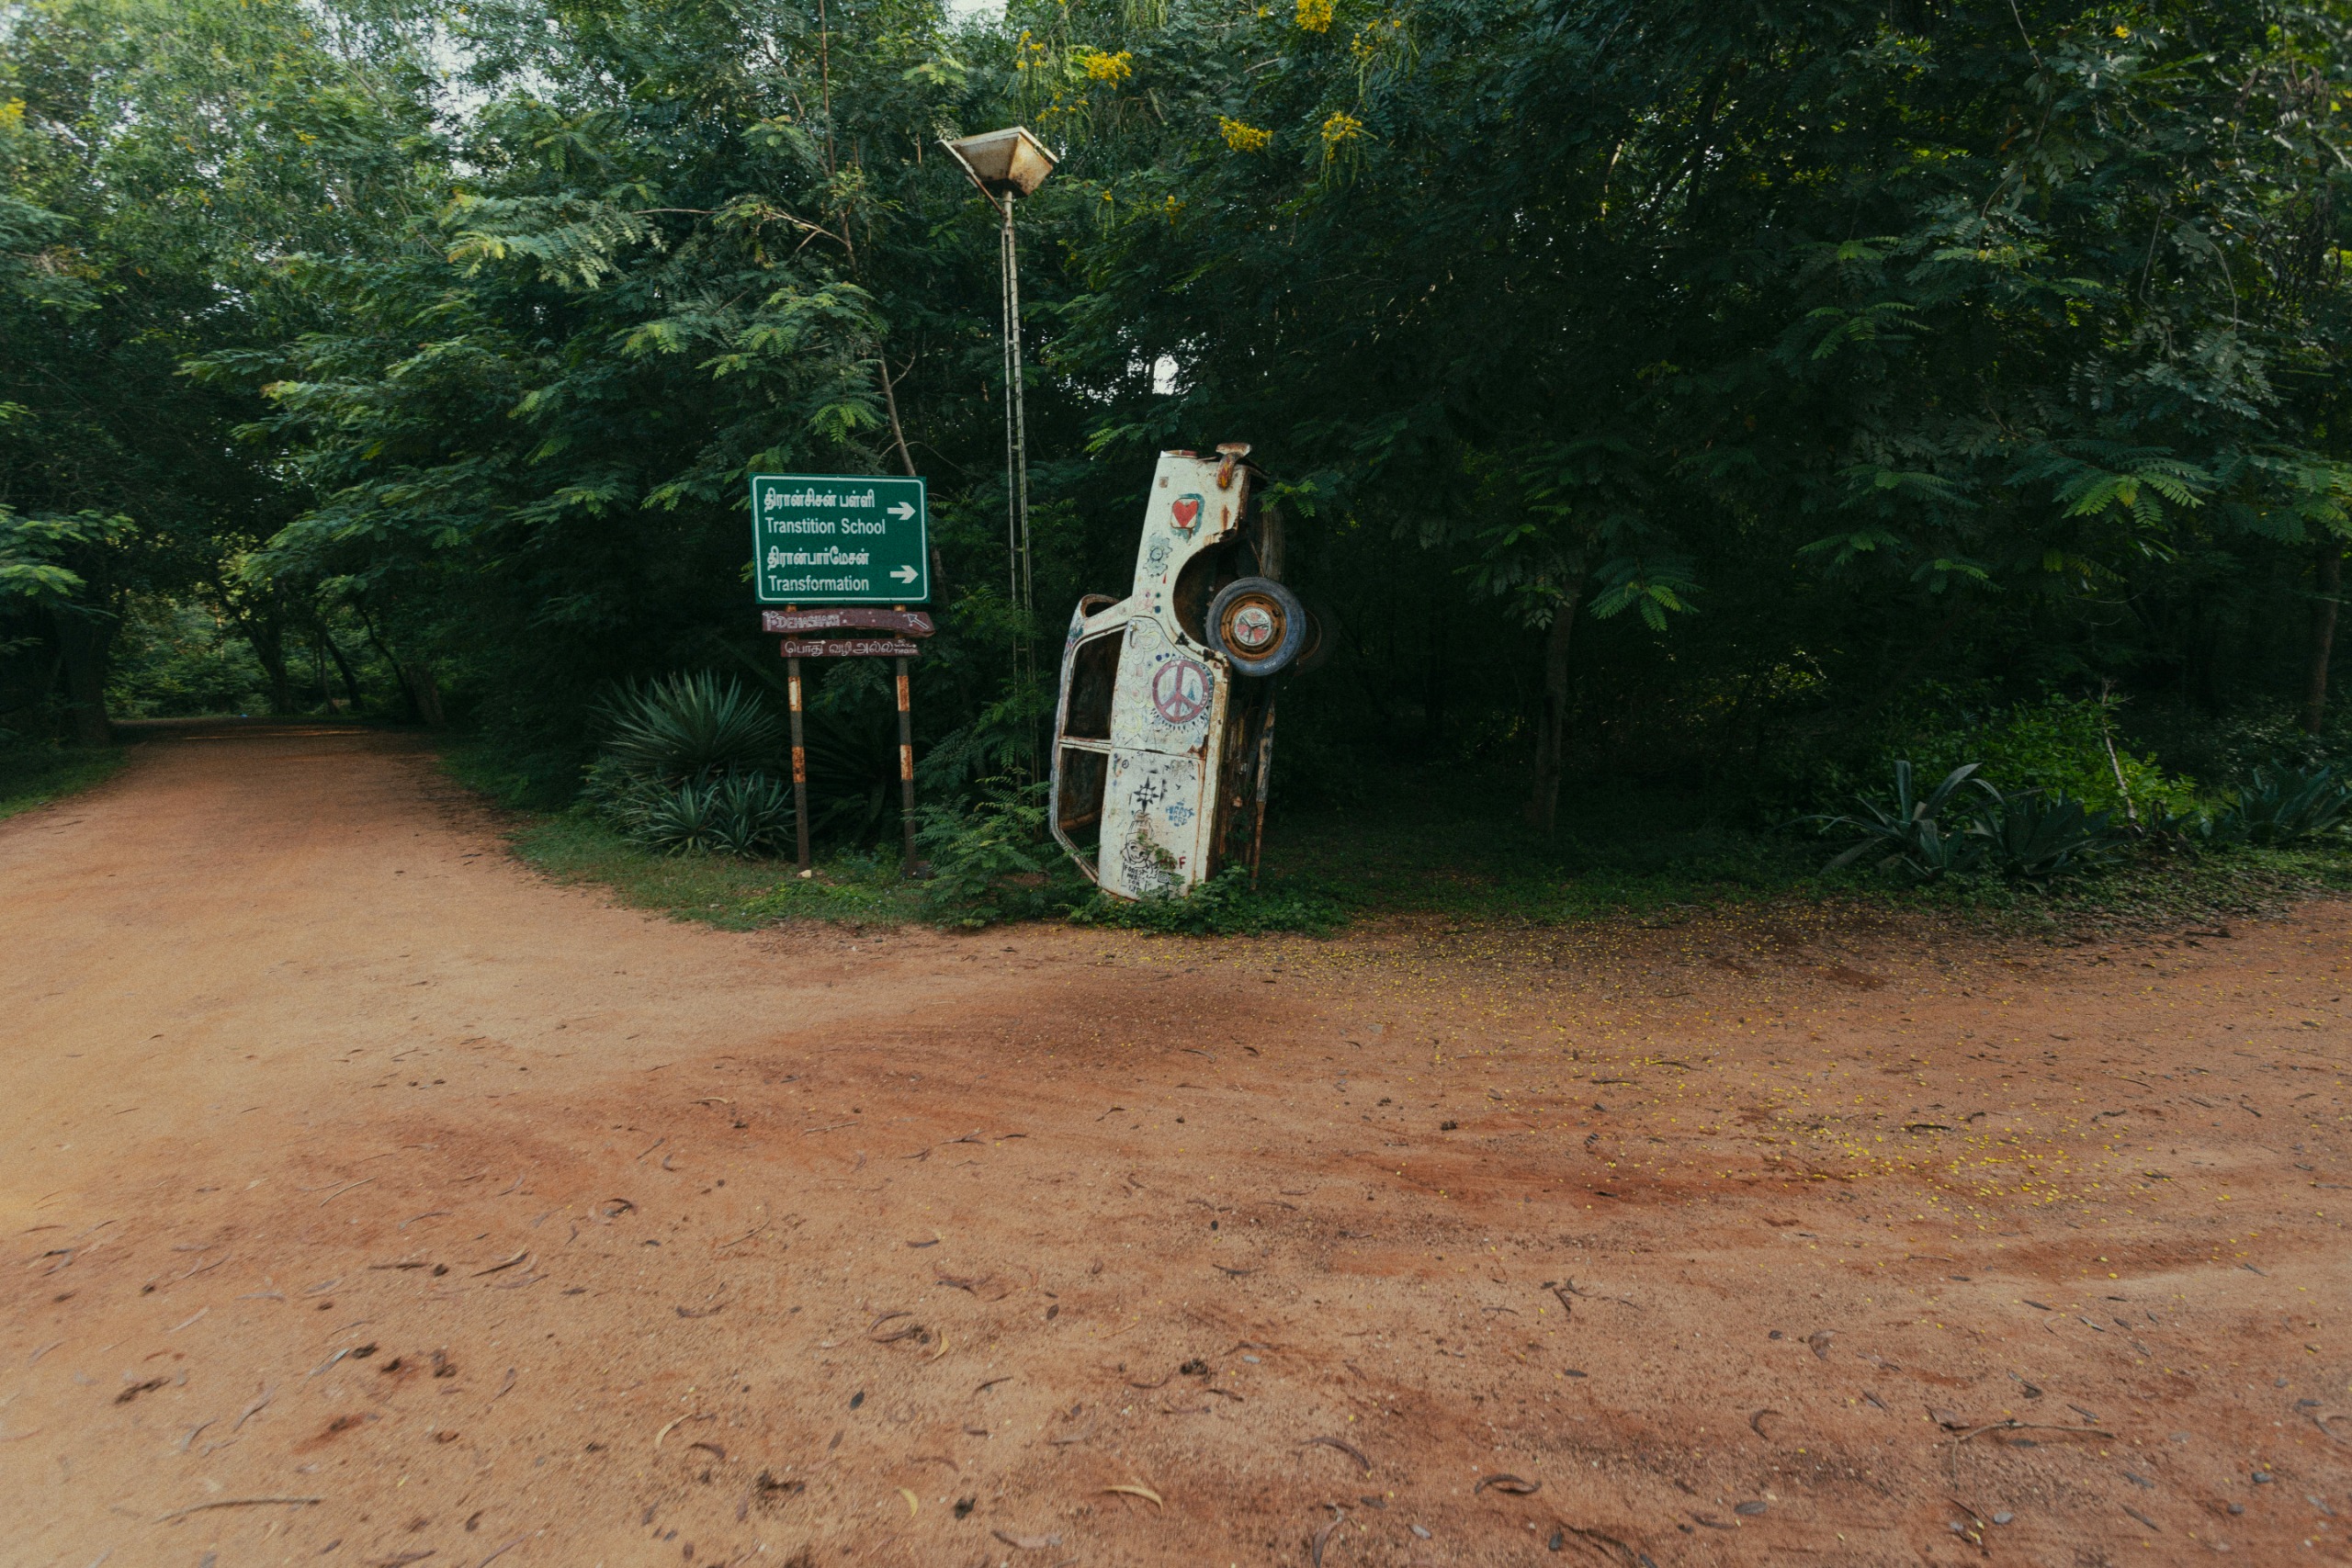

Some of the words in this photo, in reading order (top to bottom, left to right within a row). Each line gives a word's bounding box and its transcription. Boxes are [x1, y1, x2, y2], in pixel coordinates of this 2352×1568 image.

[840, 489, 876, 508] பள்ளி
[764, 516, 835, 534] Transtition
[842, 517, 886, 535] School
[768, 575, 870, 592] Transformation
